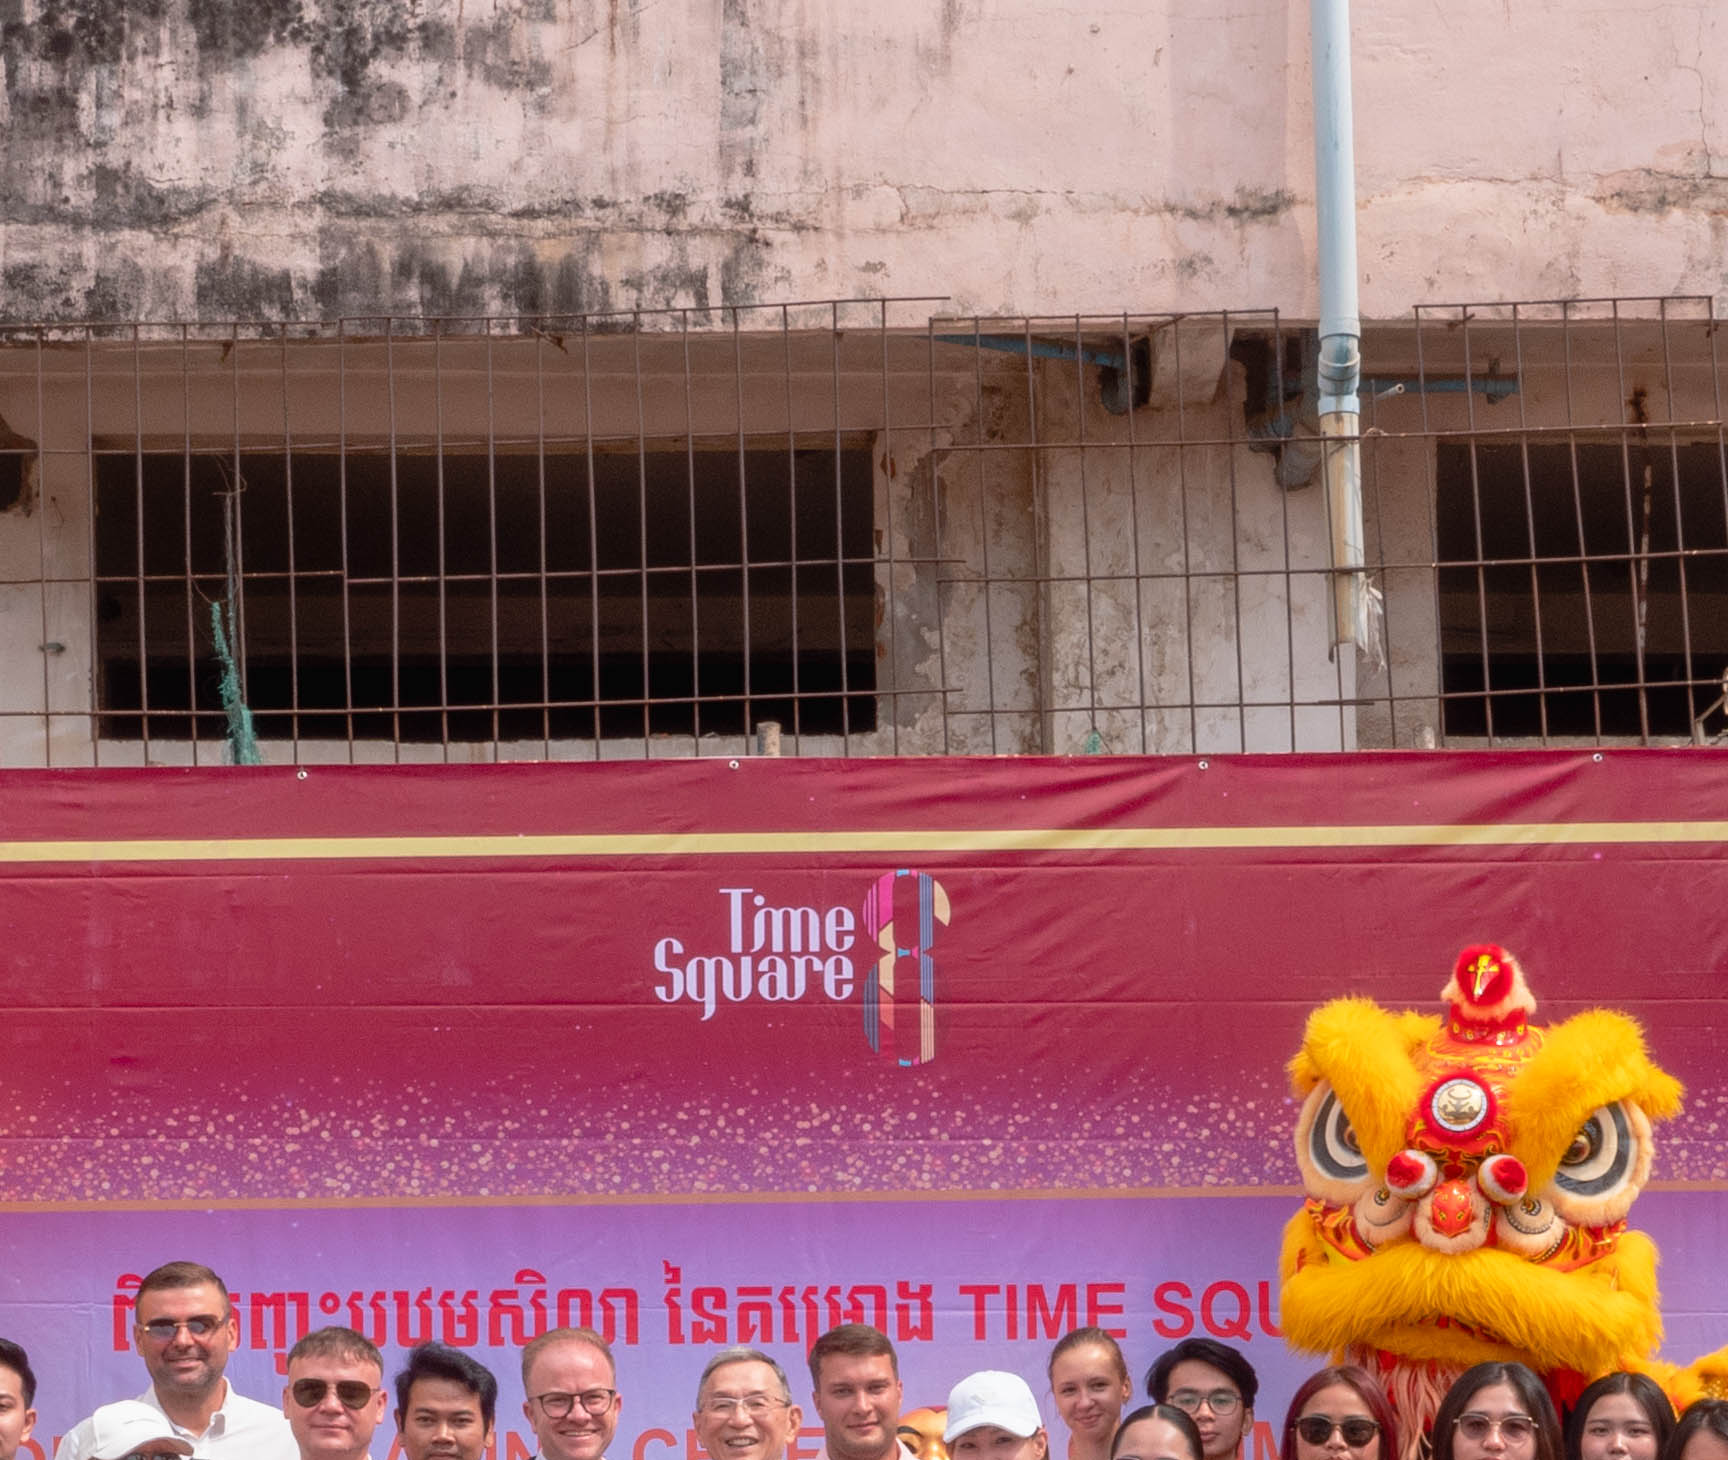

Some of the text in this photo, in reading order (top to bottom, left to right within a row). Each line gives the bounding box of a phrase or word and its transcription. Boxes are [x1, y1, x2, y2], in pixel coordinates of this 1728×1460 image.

[719, 888, 855, 953] Time
[654, 937, 854, 1022] Square
[959, 1283, 1127, 1341] TIME
[1152, 1280, 1283, 1342] SQU
